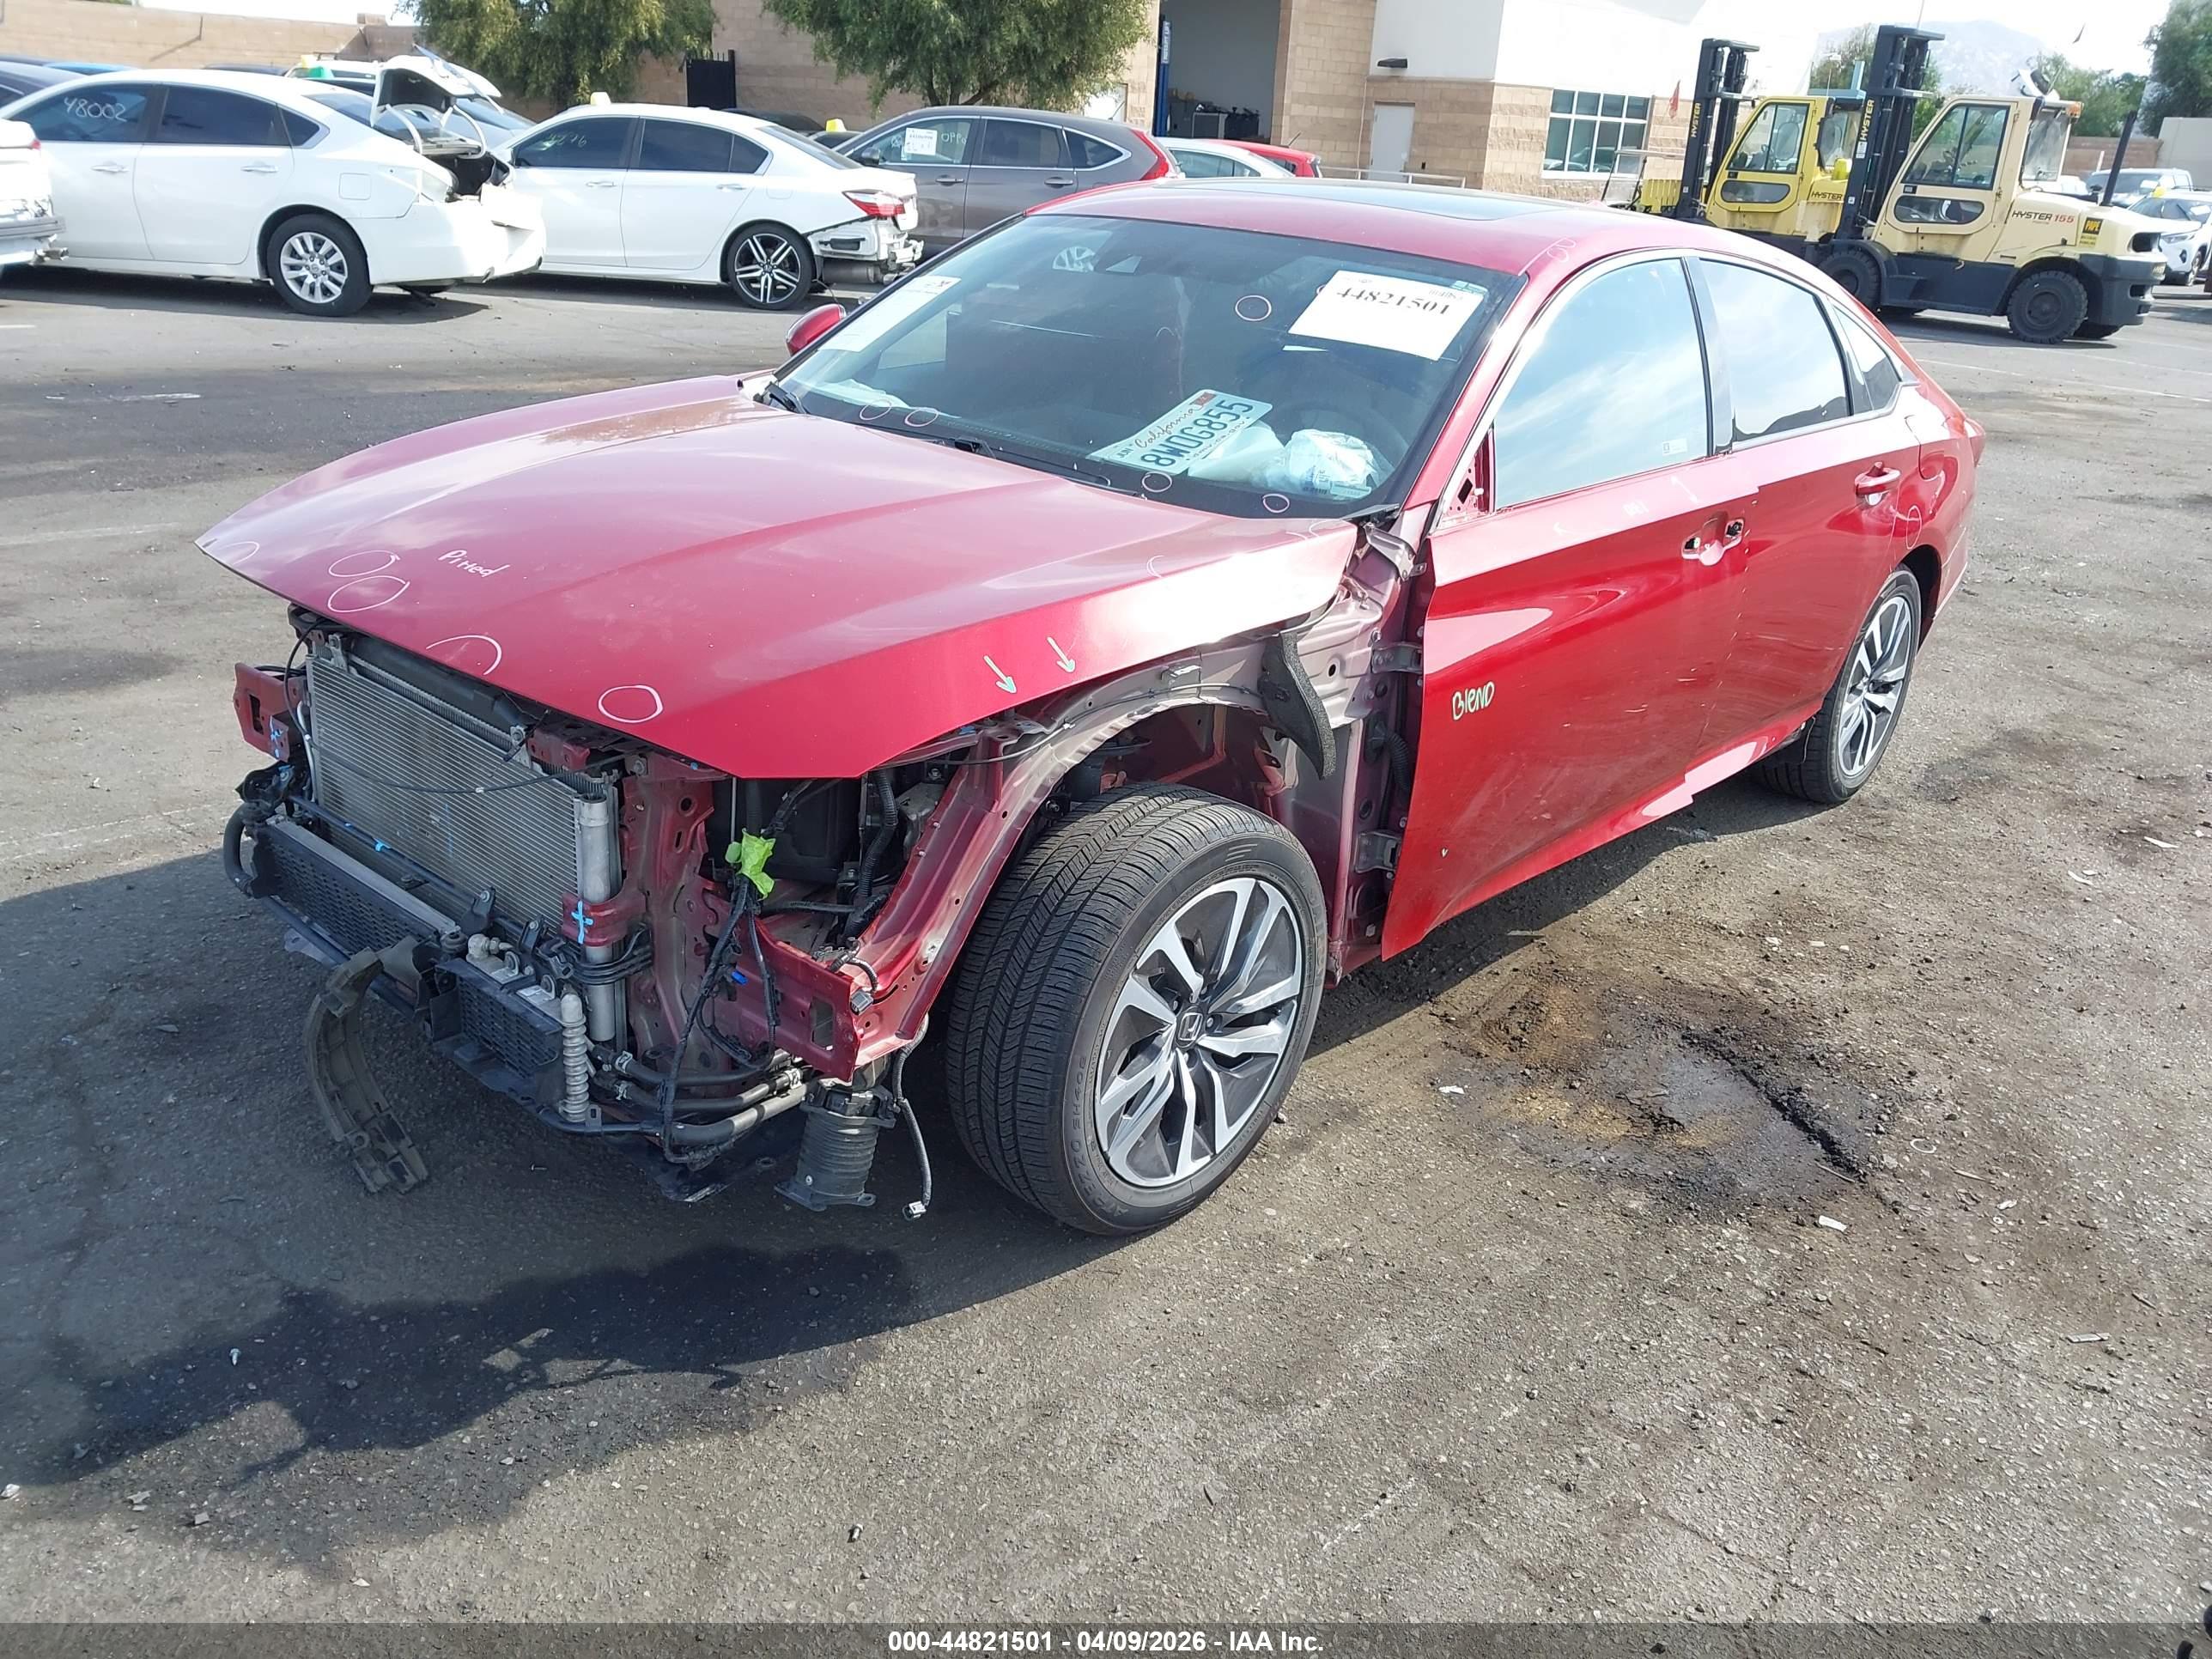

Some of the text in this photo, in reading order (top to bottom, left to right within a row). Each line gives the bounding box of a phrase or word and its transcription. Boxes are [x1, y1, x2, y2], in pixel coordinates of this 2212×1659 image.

[64, 96, 128, 123] 48002
[1691, 102, 1701, 138] HYSTER
[1860, 99, 1875, 141] HYSTER
[1811, 191, 1844, 201] HYSTER
[2011, 210, 2053, 221] HYSTER
[2054, 214, 2076, 223] 155
[1336, 287, 1450, 315] 44821501
[1134, 407, 1194, 449] California
